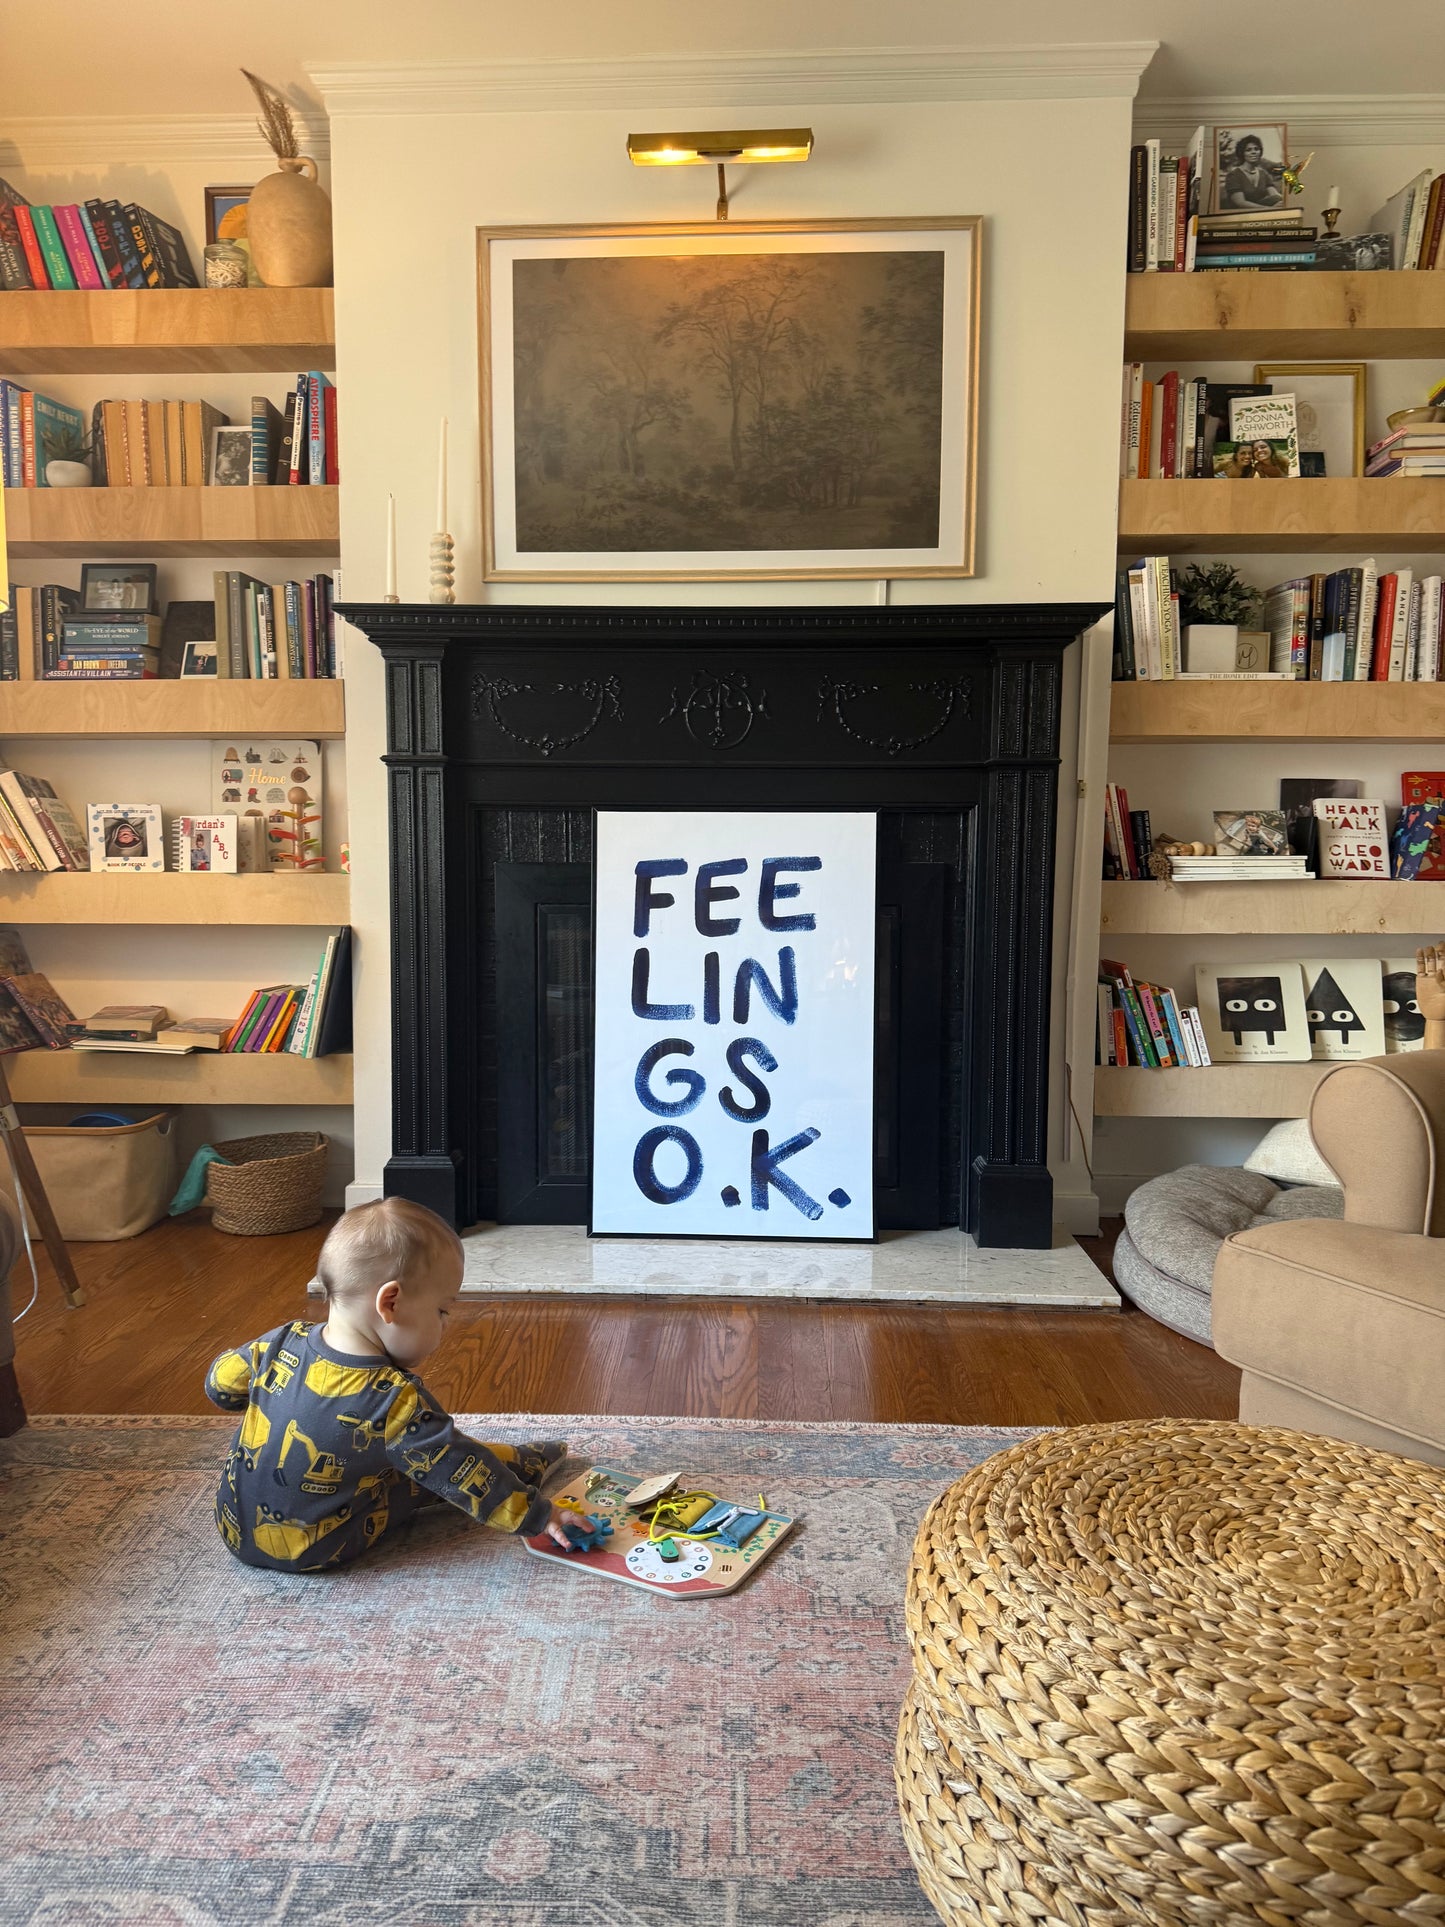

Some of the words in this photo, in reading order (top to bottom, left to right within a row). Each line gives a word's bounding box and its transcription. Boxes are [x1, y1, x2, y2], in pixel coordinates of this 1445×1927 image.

[131, 225, 147, 253] DUST
[0, 253, 15, 282] FLAMES
[6, 248, 19, 272] COURT
[11, 406, 20, 429] BEACH
[310, 377, 320, 441] ATMOSPHERE
[1245, 413, 1284, 423] DONNA
[25, 422, 33, 441] LOVERS
[1132, 401, 1141, 448] Educated
[1237, 421, 1293, 432] ASHWORTH
[11, 431, 20, 449] READ
[1161, 564, 1170, 607] TEACHING
[1349, 587, 1358, 605] OVER
[1363, 585, 1374, 623] Atomic
[1398, 589, 1407, 622] RANGE
[1163, 607, 1171, 633] YOGA
[1346, 613, 1356, 650] INFLUENCE
[1360, 625, 1371, 658] Habits
[72, 660, 82, 669] DAN
[83, 660, 100, 669] BROWN
[107, 660, 127, 669] INFERNO
[248, 768, 286, 785] Home
[1326, 805, 1379, 815] HEART
[196, 818, 224, 828] rdan's
[1326, 817, 1380, 831] TALK
[213, 834, 220, 843] A
[218, 843, 225, 851] B
[223, 851, 228, 859] C
[1329, 844, 1382, 857] CLEO
[1329, 859, 1384, 871] WADE
[633, 855, 823, 938] FEE
[631, 946, 799, 1026] LIN
[634, 1037, 779, 1123] GS
[632, 1124, 852, 1221] O.K.
